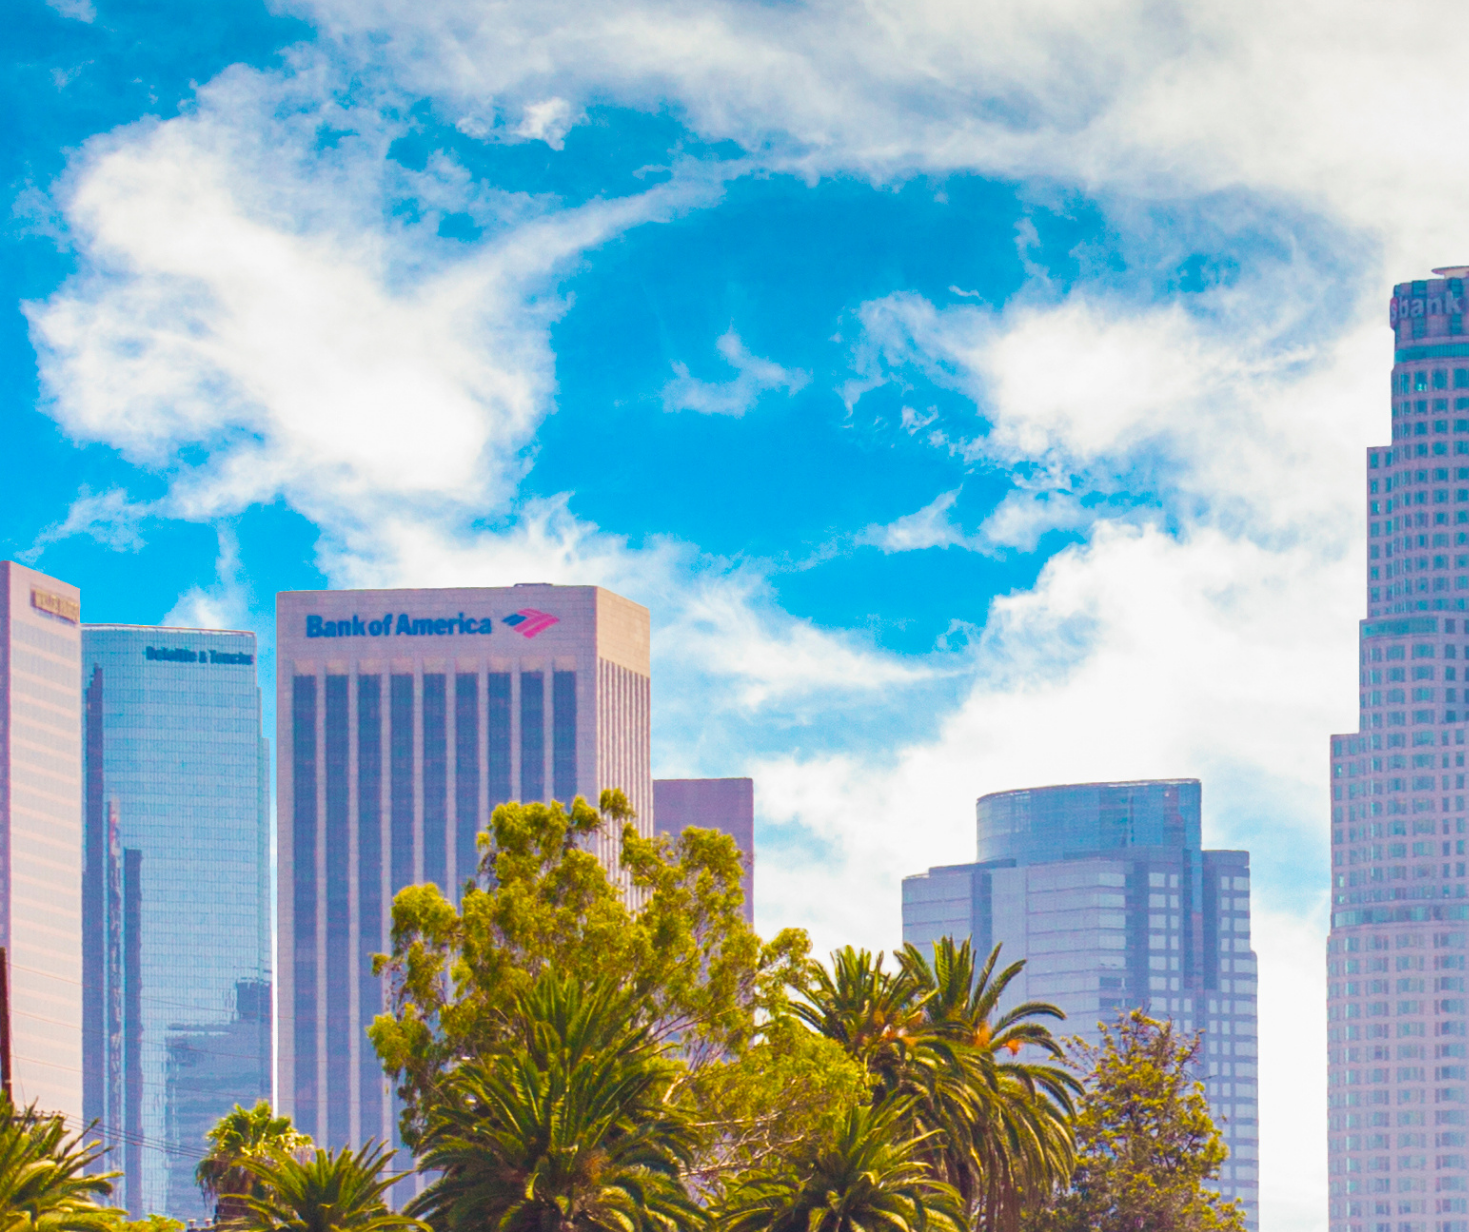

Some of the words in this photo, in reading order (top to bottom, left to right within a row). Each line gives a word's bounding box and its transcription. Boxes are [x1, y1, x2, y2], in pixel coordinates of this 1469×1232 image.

[306, 614, 365, 638] Bank
[368, 614, 393, 636] of
[396, 612, 492, 636] America
